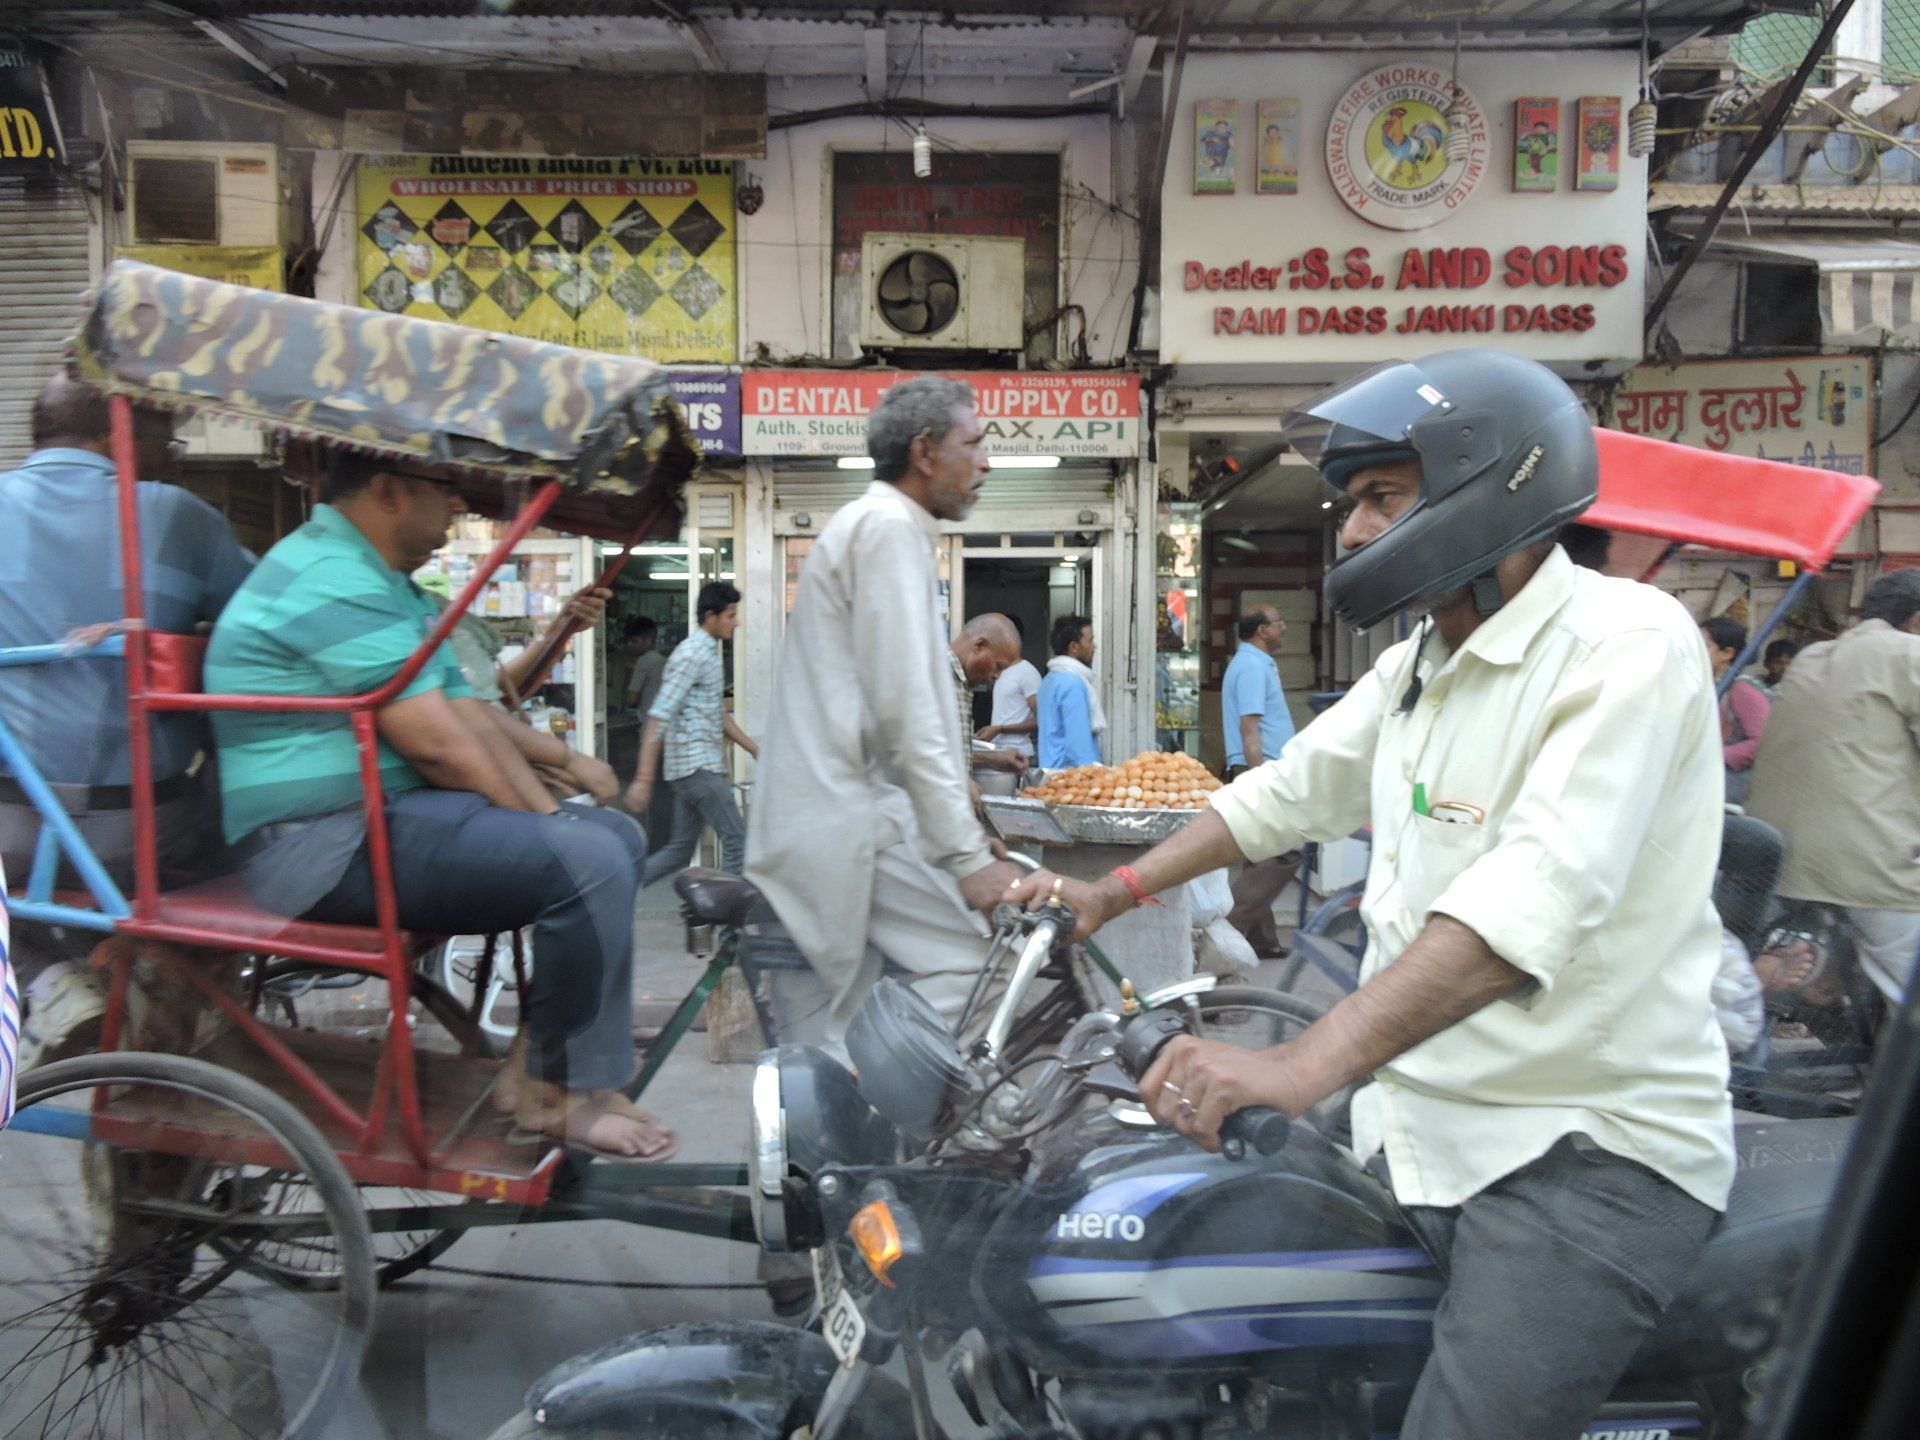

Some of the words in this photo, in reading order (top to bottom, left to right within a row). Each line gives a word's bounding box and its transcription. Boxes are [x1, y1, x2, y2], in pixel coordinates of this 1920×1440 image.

[1375, 67, 1440, 89] WORKS
[1340, 81, 1374, 116] FIRE
[1330, 118, 1368, 209] KALISWARI
[1444, 148, 1485, 209] LIMITED
[397, 180, 538, 194] WHOLESALE
[546, 180, 617, 194] PRICE
[625, 180, 691, 195] SHOP
[1367, 180, 1408, 204] TRADE
[1412, 181, 1449, 204] MARK
[1396, 247, 1492, 290] AND
[1503, 244, 1628, 288] SONS
[1214, 306, 1286, 335] RAM
[1297, 306, 1388, 335] DASS
[1396, 305, 1495, 333] JANKI
[1503, 304, 1596, 333] DASS
[757, 387, 870, 414] DENTAL
[1081, 389, 1127, 416] CO.
[1616, 390, 1687, 434] राम
[1699, 368, 1807, 451] दुलारे
[756, 420, 801, 436] Auth.
[1052, 421, 1124, 440] API
[821, 441, 865, 451] Ground
[992, 443, 1032, 454] Masjid,
[1036, 443, 1108, 453] Delhi-110006
